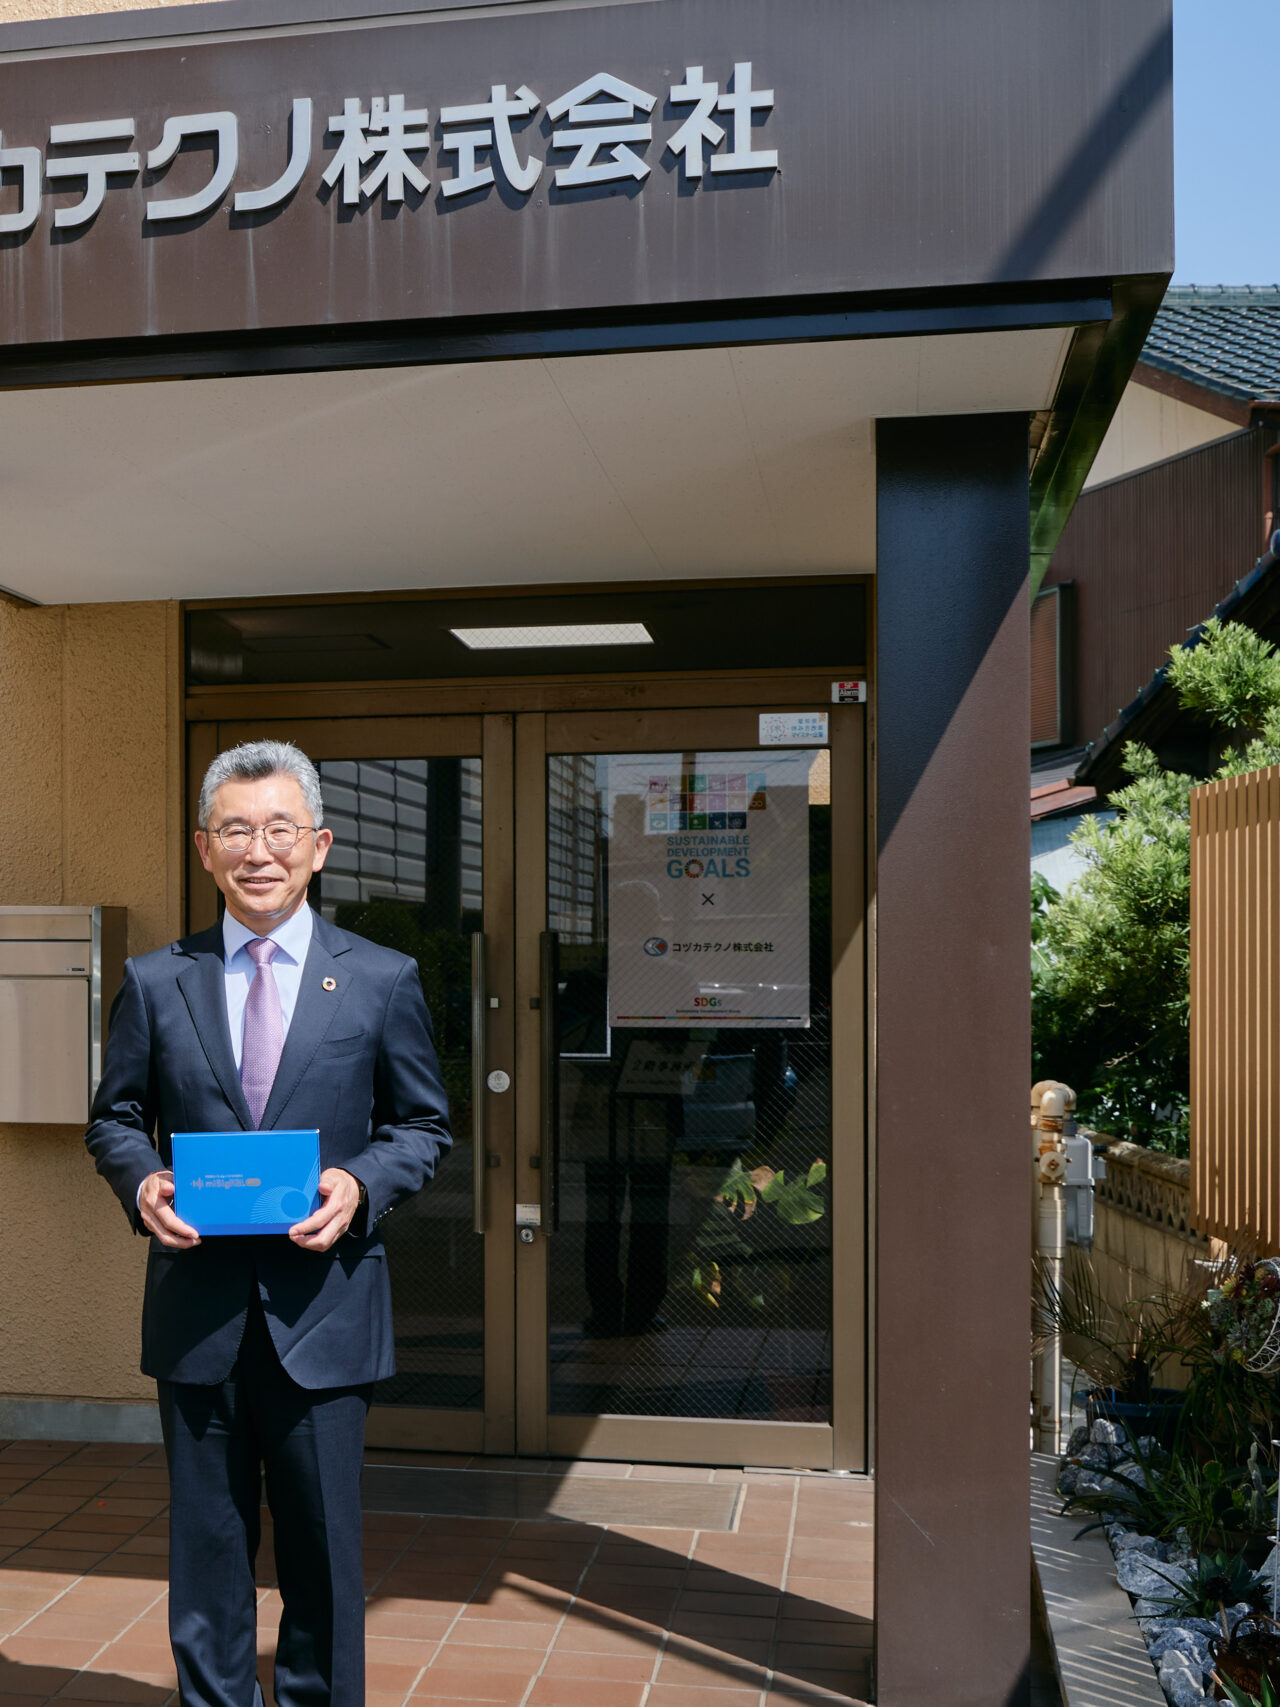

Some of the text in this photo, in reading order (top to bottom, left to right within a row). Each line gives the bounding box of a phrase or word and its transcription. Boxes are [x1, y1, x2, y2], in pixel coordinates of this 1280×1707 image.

[666, 835, 750, 846] SUSTAINABLE
[666, 847, 750, 857] DEVELOPMENT
[666, 857, 751, 879] GOALS
[672, 942, 775, 953] コヅカテクノ株式会社
[694, 997, 722, 1007] SDGs
